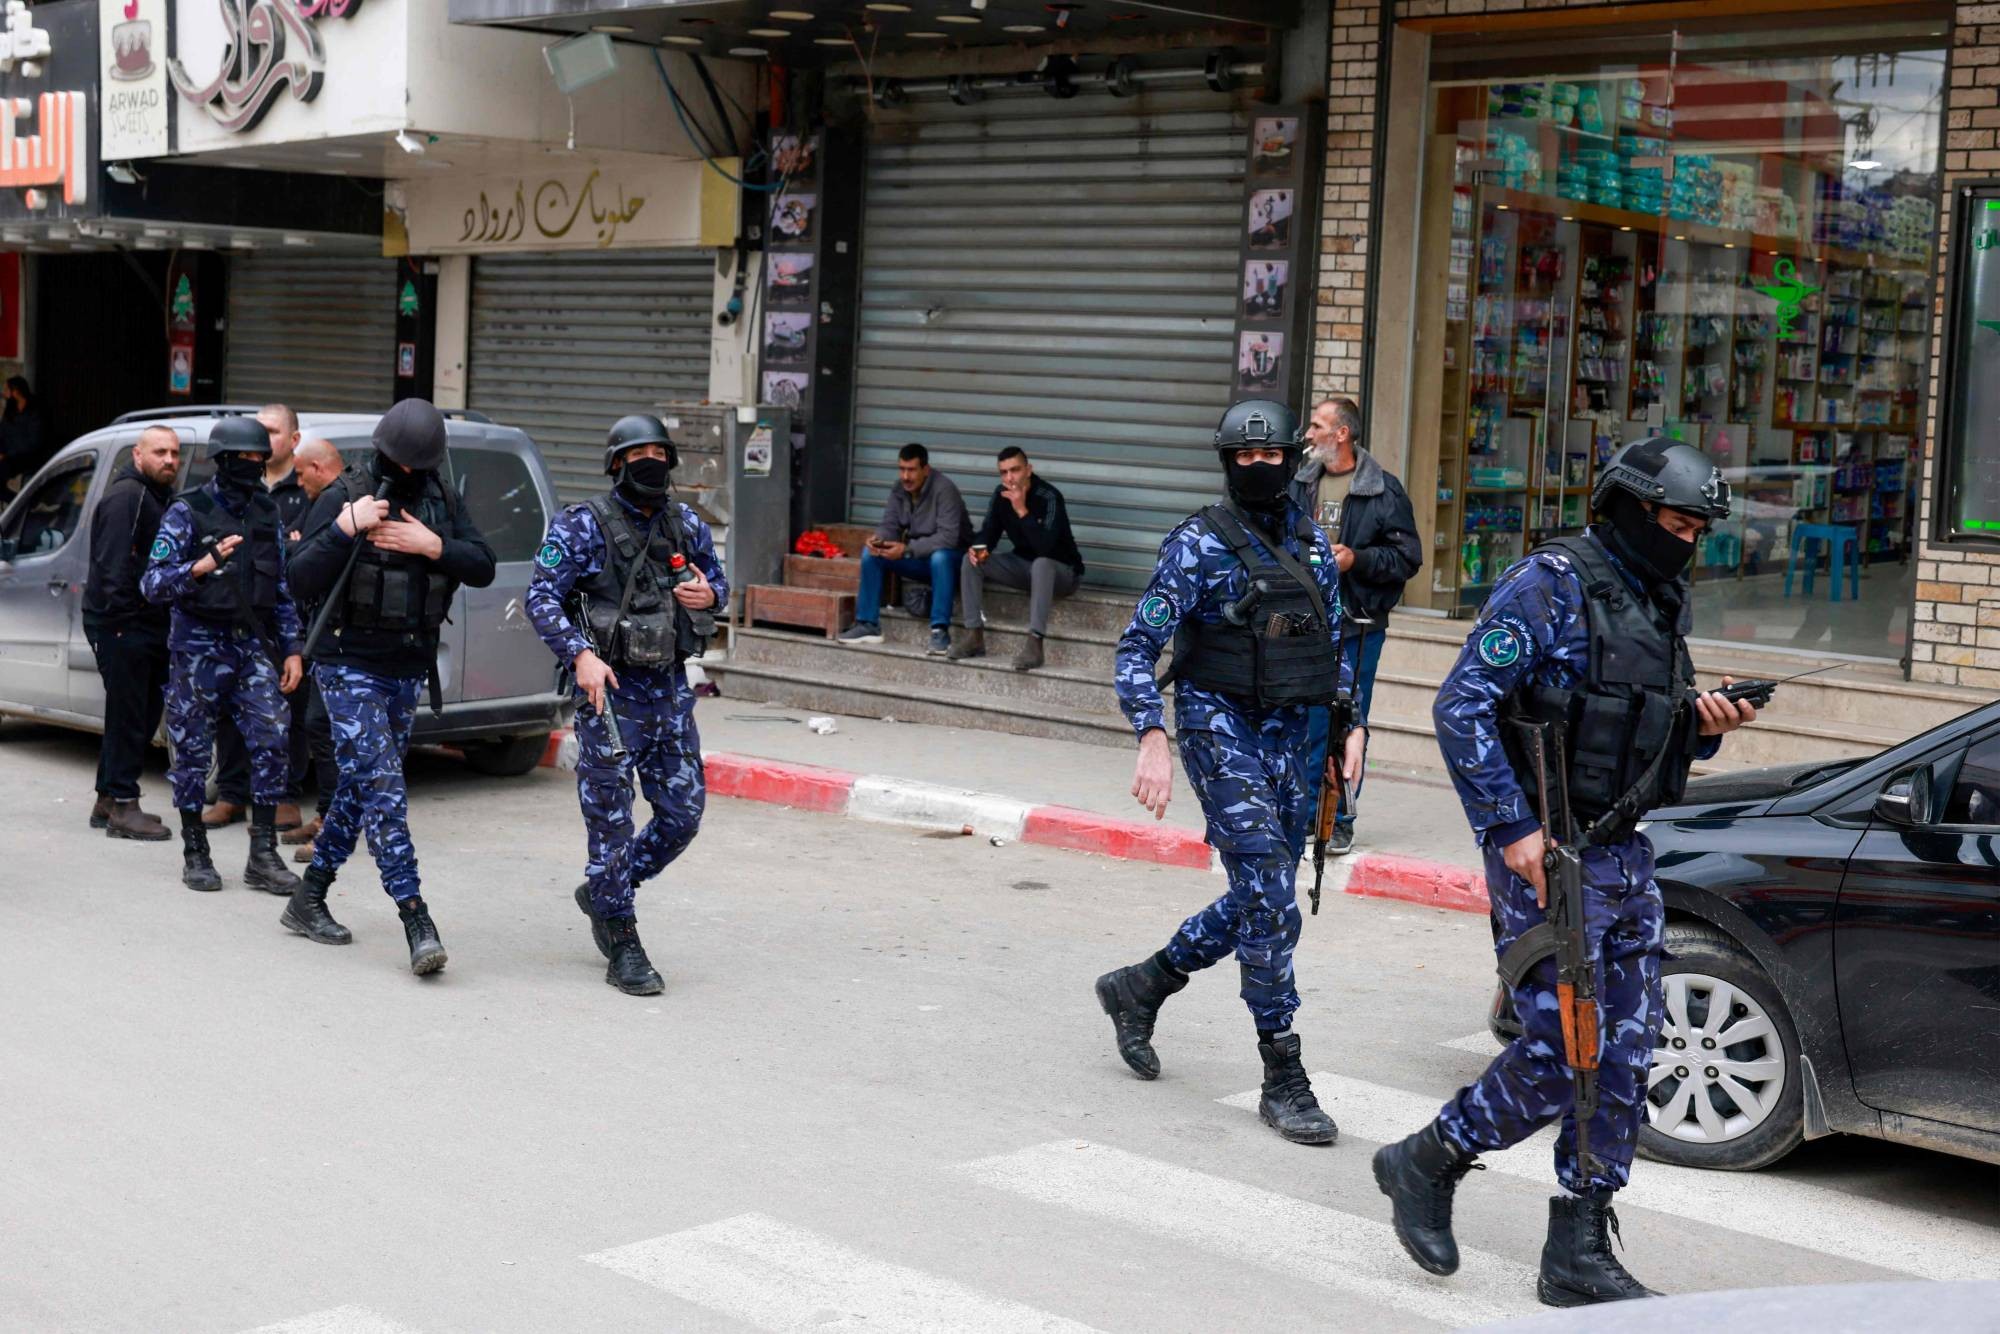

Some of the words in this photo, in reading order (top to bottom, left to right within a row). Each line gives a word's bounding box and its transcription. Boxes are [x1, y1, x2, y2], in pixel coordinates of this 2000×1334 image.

[109, 88, 159, 111] ARWAD
[111, 108, 150, 139] SWEETS
[458, 180, 524, 242] أرواد
[534, 166, 645, 248] حلويات
